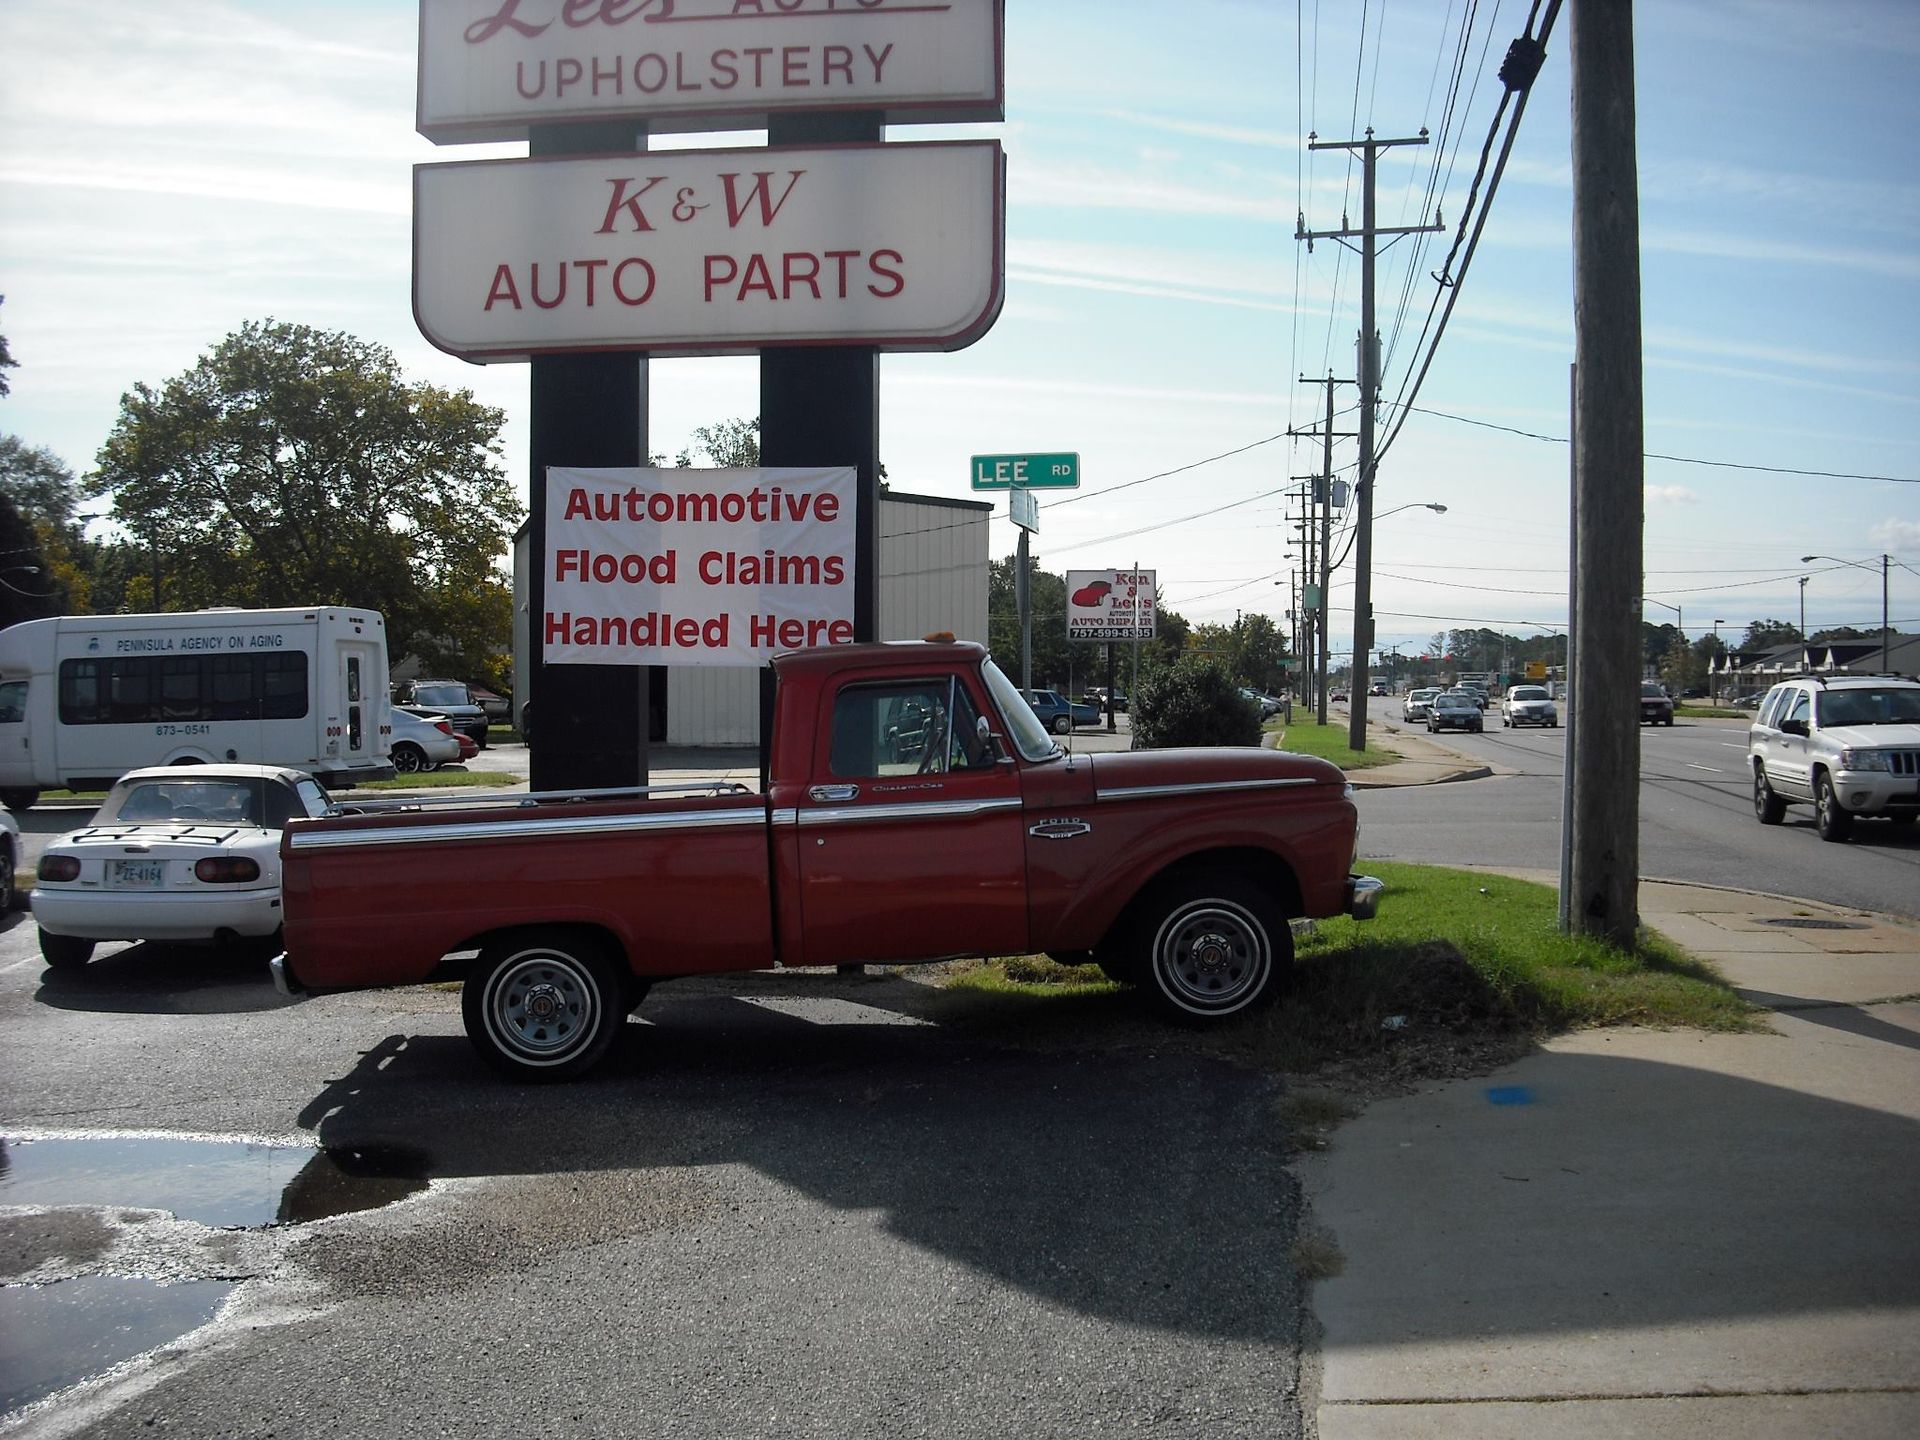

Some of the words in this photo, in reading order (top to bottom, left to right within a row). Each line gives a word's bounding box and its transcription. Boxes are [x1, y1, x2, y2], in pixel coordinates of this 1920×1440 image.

[516, 43, 894, 99] UPHOLSTERY
[593, 176, 669, 234] K
[672, 187, 710, 222] &
[717, 170, 807, 228] W
[484, 257, 656, 311] AUTO
[704, 249, 905, 303] PARTS
[978, 461, 1029, 482] LEE
[1052, 465, 1071, 475] RD
[564, 487, 839, 523] Automotive
[556, 550, 676, 584] Flood
[699, 550, 844, 585] Claims
[1115, 573, 1149, 585] Ken
[545, 612, 729, 648] Handled
[751, 614, 853, 648] Here
[1071, 618, 1103, 626] AUTO
[117, 638, 174, 652] PENINSULA
[180, 637, 223, 649] AGENCY
[229, 636, 244, 648] ON
[250, 635, 283, 647] AGING
[156, 725, 210, 736] 873-0541
